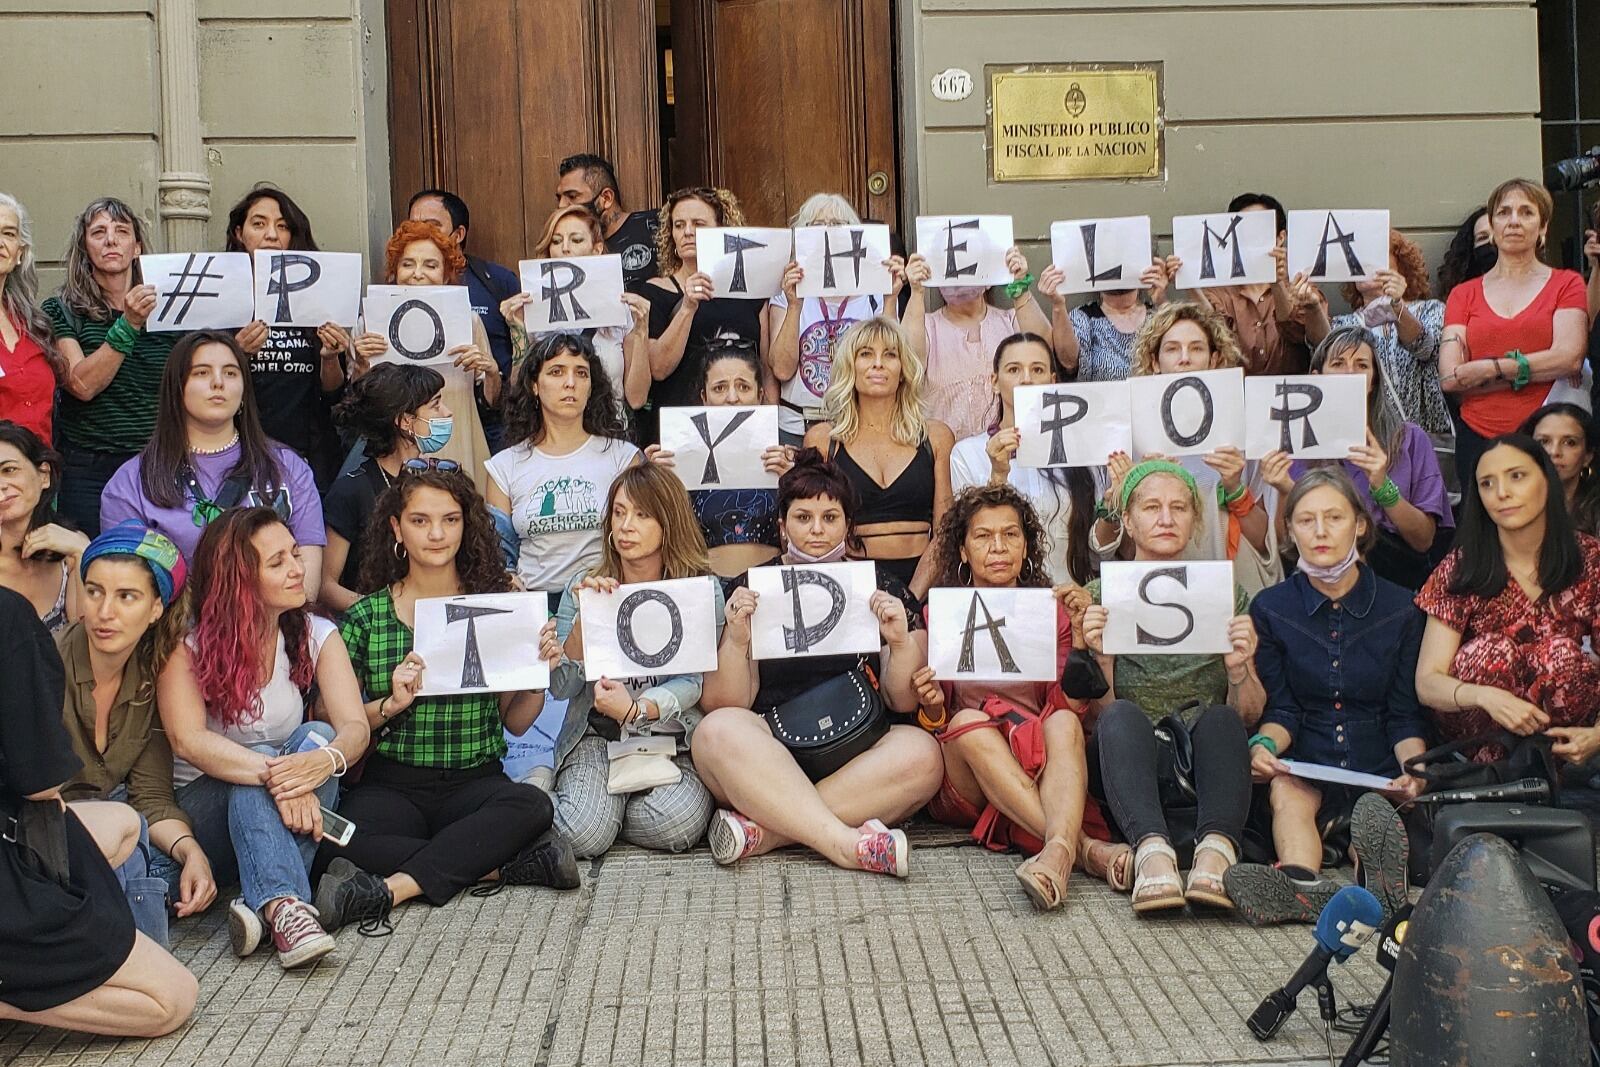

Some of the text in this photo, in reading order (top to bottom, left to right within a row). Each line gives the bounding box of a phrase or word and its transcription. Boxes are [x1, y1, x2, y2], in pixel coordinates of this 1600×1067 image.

[938, 76, 966, 94] 667
[1002, 121, 1150, 138] MINISTERIO PUBLICO
[1006, 141, 1147, 158] FISCAL DE LA NACION
[257, 351, 292, 361] ESTAR
[283, 362, 314, 373] OTRO
[690, 410, 755, 485] Y
[529, 515, 597, 529] ACTRICES
